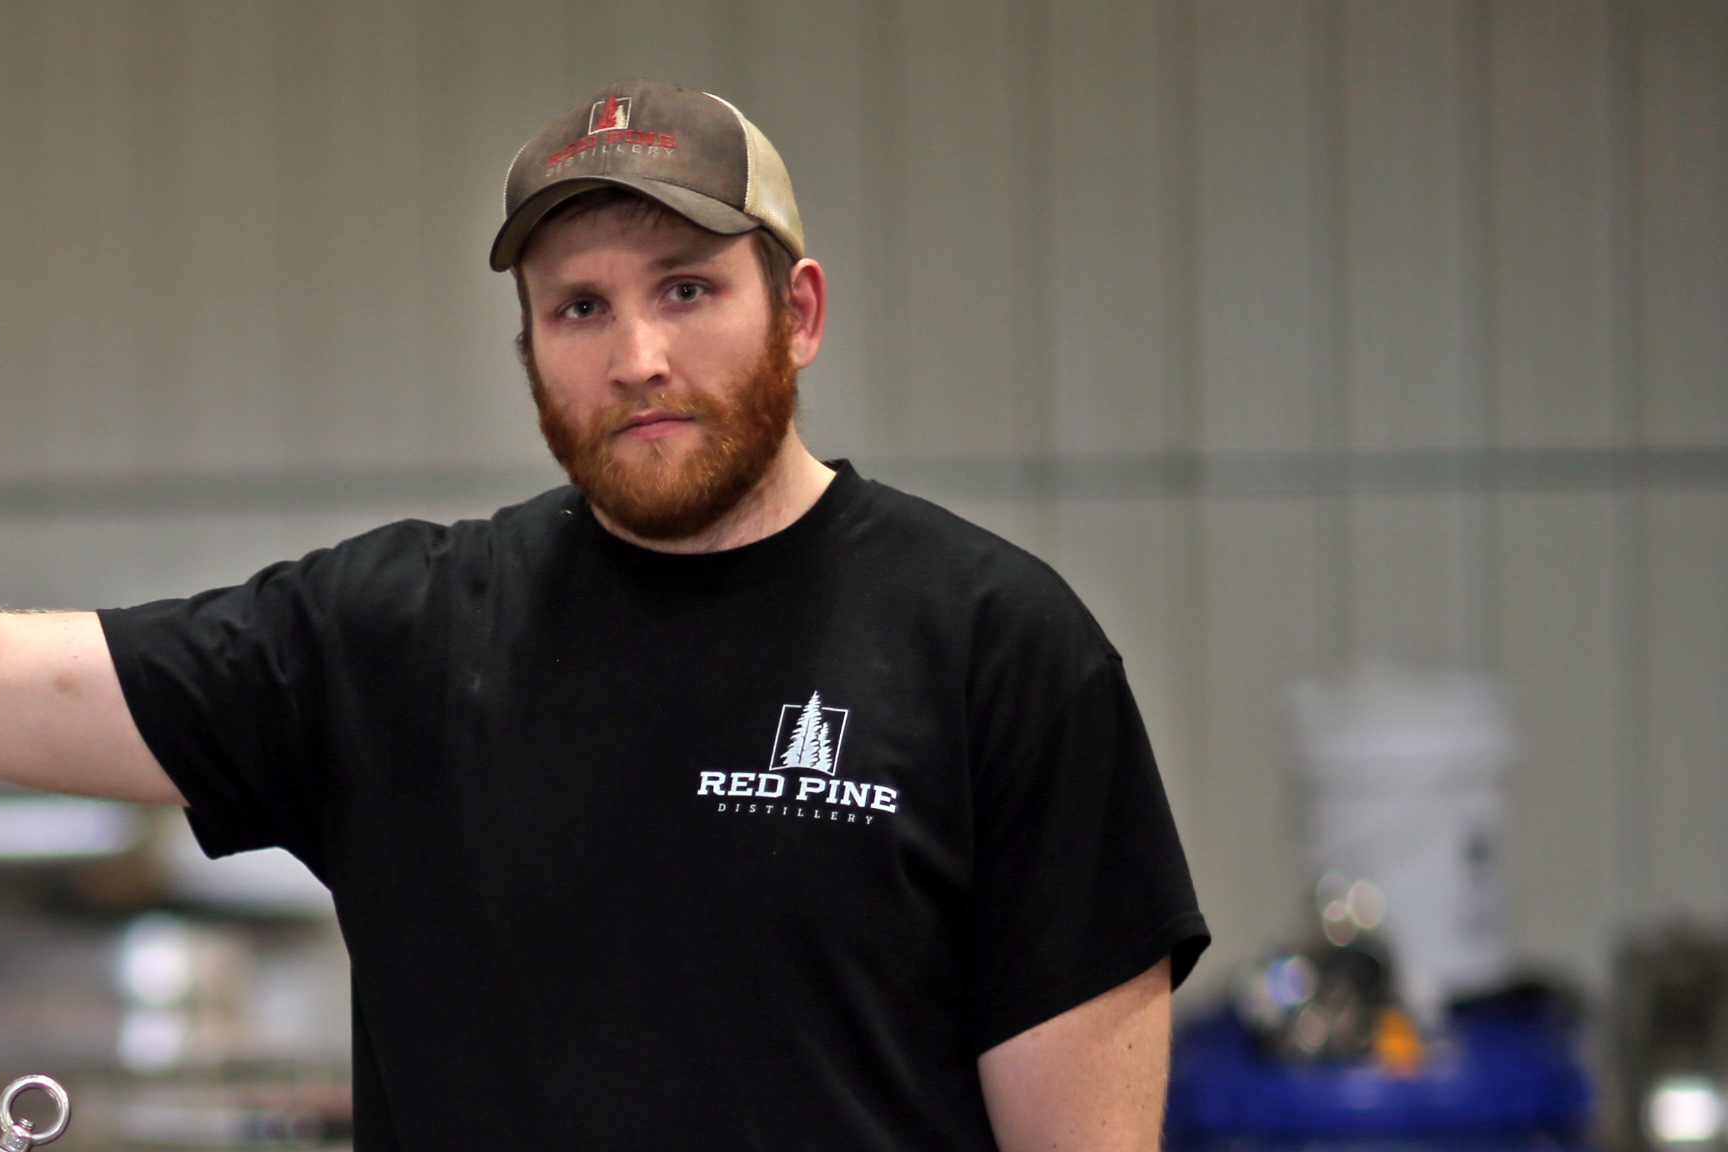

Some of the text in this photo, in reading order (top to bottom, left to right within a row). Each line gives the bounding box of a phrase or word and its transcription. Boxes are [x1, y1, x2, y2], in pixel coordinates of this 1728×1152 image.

[546, 144, 674, 177] DISTILLERY
[547, 129, 675, 168] RED PINE
[697, 771, 897, 814] RED PINE
[718, 803, 873, 825] DISTILLERY
